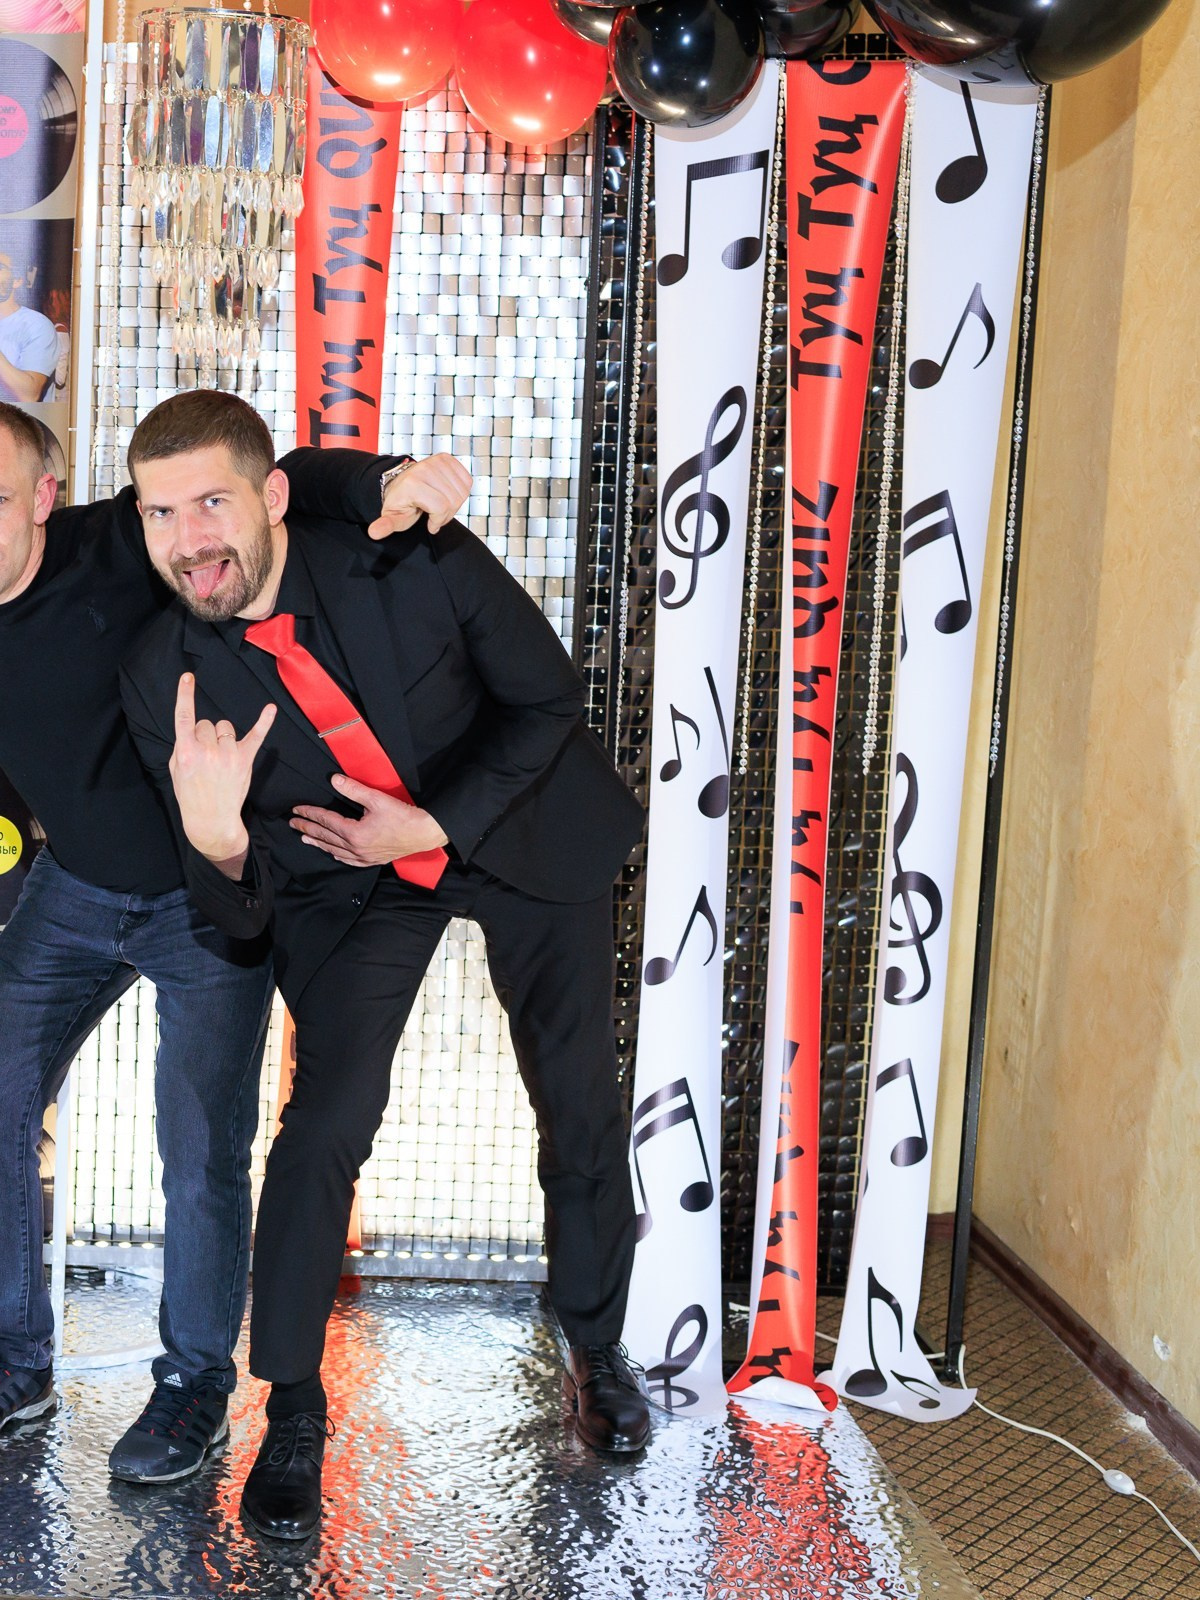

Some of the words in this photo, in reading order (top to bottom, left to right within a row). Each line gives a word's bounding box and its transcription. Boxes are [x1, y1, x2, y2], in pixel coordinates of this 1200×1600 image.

[796, 113, 880, 241] Туц
[312, 203, 383, 316] Туц
[790, 266, 865, 392] Туц
[308, 338, 376, 448] Туц
